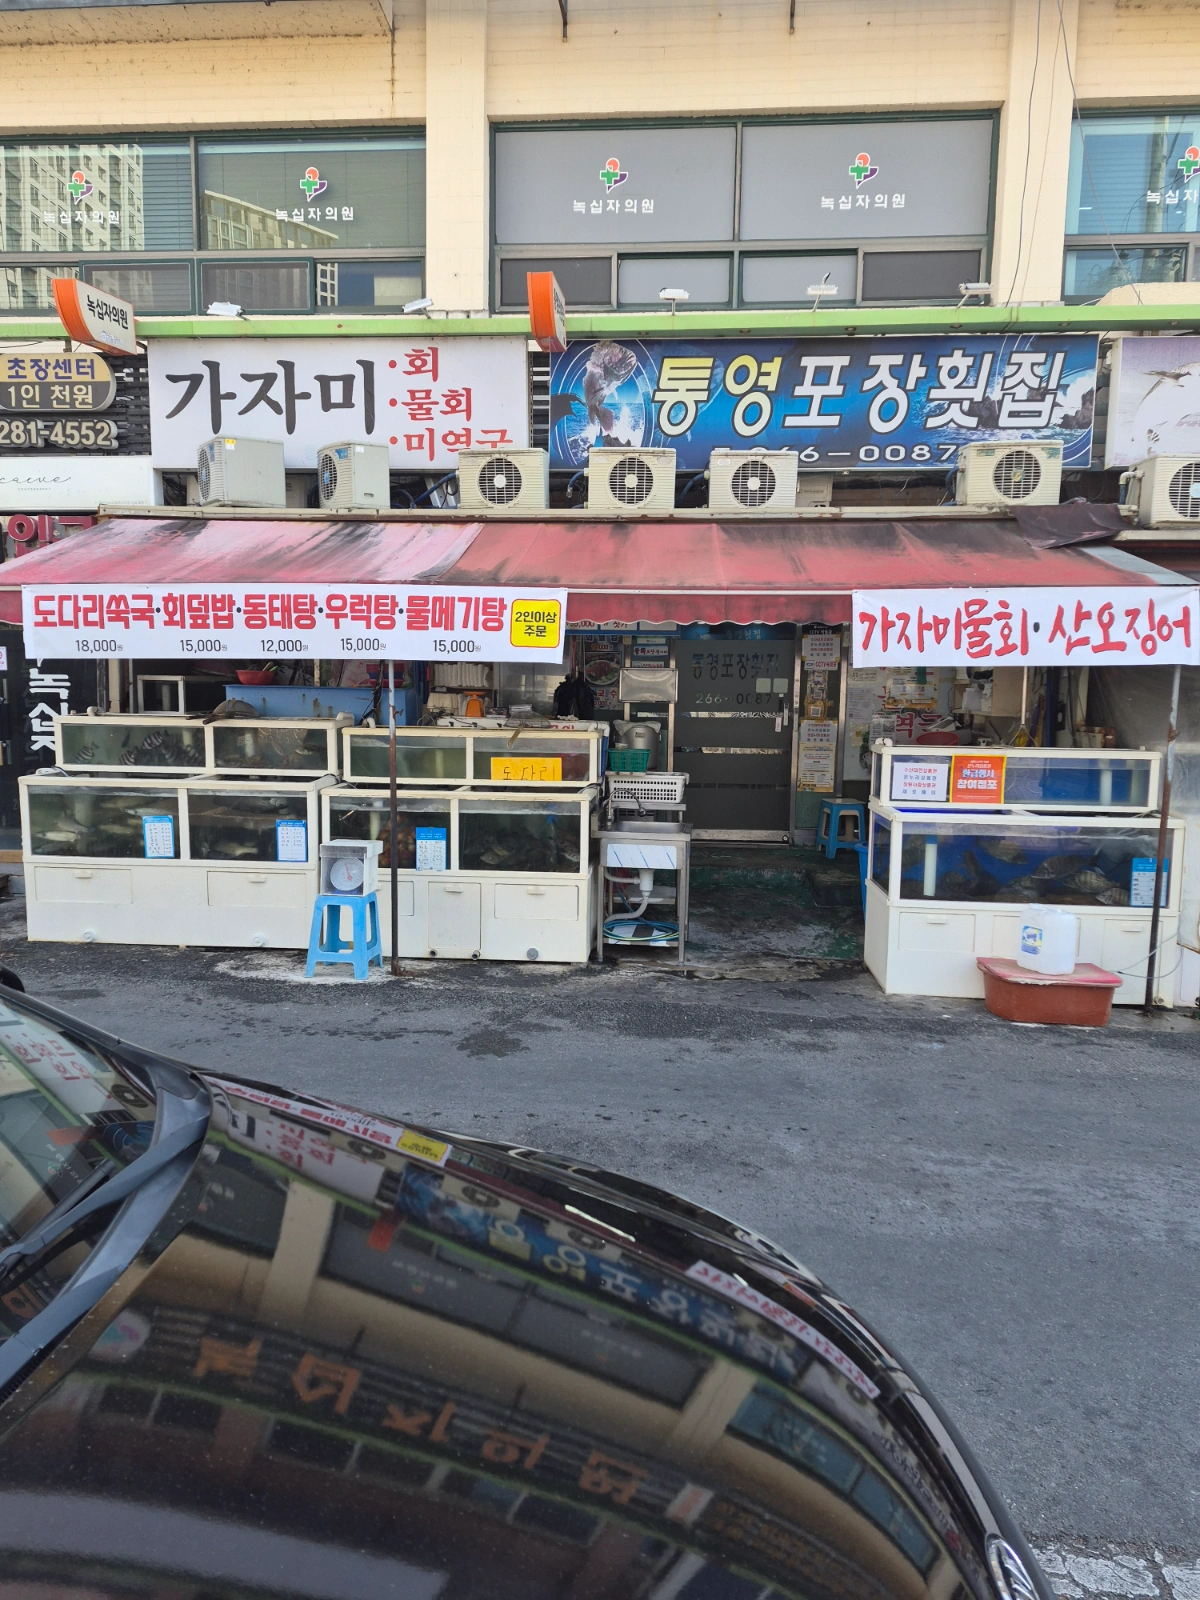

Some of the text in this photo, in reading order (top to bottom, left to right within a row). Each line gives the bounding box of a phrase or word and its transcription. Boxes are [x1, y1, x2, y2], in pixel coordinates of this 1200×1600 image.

[573, 198, 655, 215] 녹십자의원
[820, 193, 906, 211] 녹십자의원
[43, 210, 120, 225] 녹십자의원
[275, 206, 354, 222] 녹십자의원
[86, 294, 129, 330] 녹십자의원
[7, 357, 96, 380] 초장센터
[402, 346, 439, 382] 회
[7, 384, 93, 409] 1인 천원
[165, 359, 375, 435] 가자미
[401, 387, 472, 422] 물회
[652, 349, 1066, 438] 통영포장횟집
[514, 610, 557, 625] 2인이상
[523, 625, 547, 638] 주문
